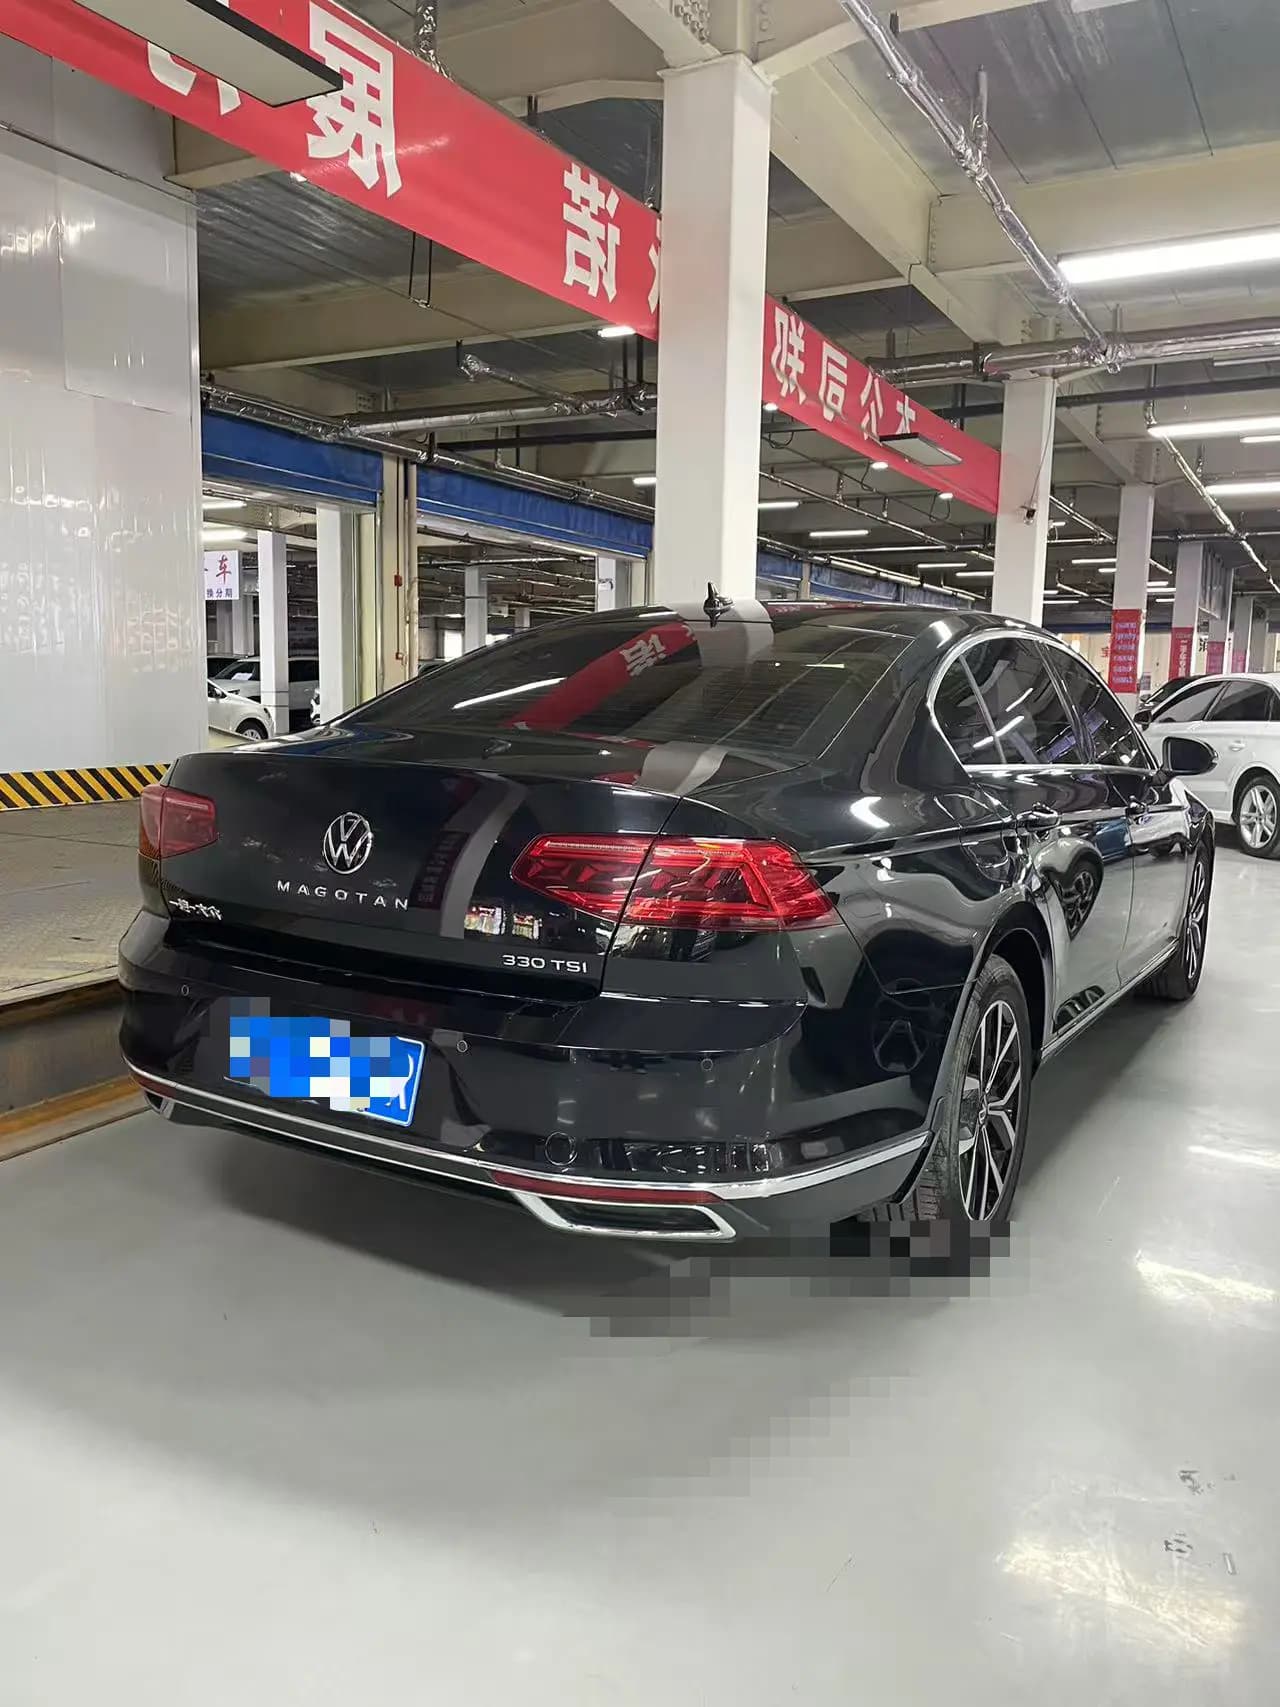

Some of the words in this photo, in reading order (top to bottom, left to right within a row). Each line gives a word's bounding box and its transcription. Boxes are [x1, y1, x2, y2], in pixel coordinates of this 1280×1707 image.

[277, 880, 409, 911] MAGOTAN
[502, 954, 546, 969] 330
[550, 959, 588, 973] TSI
